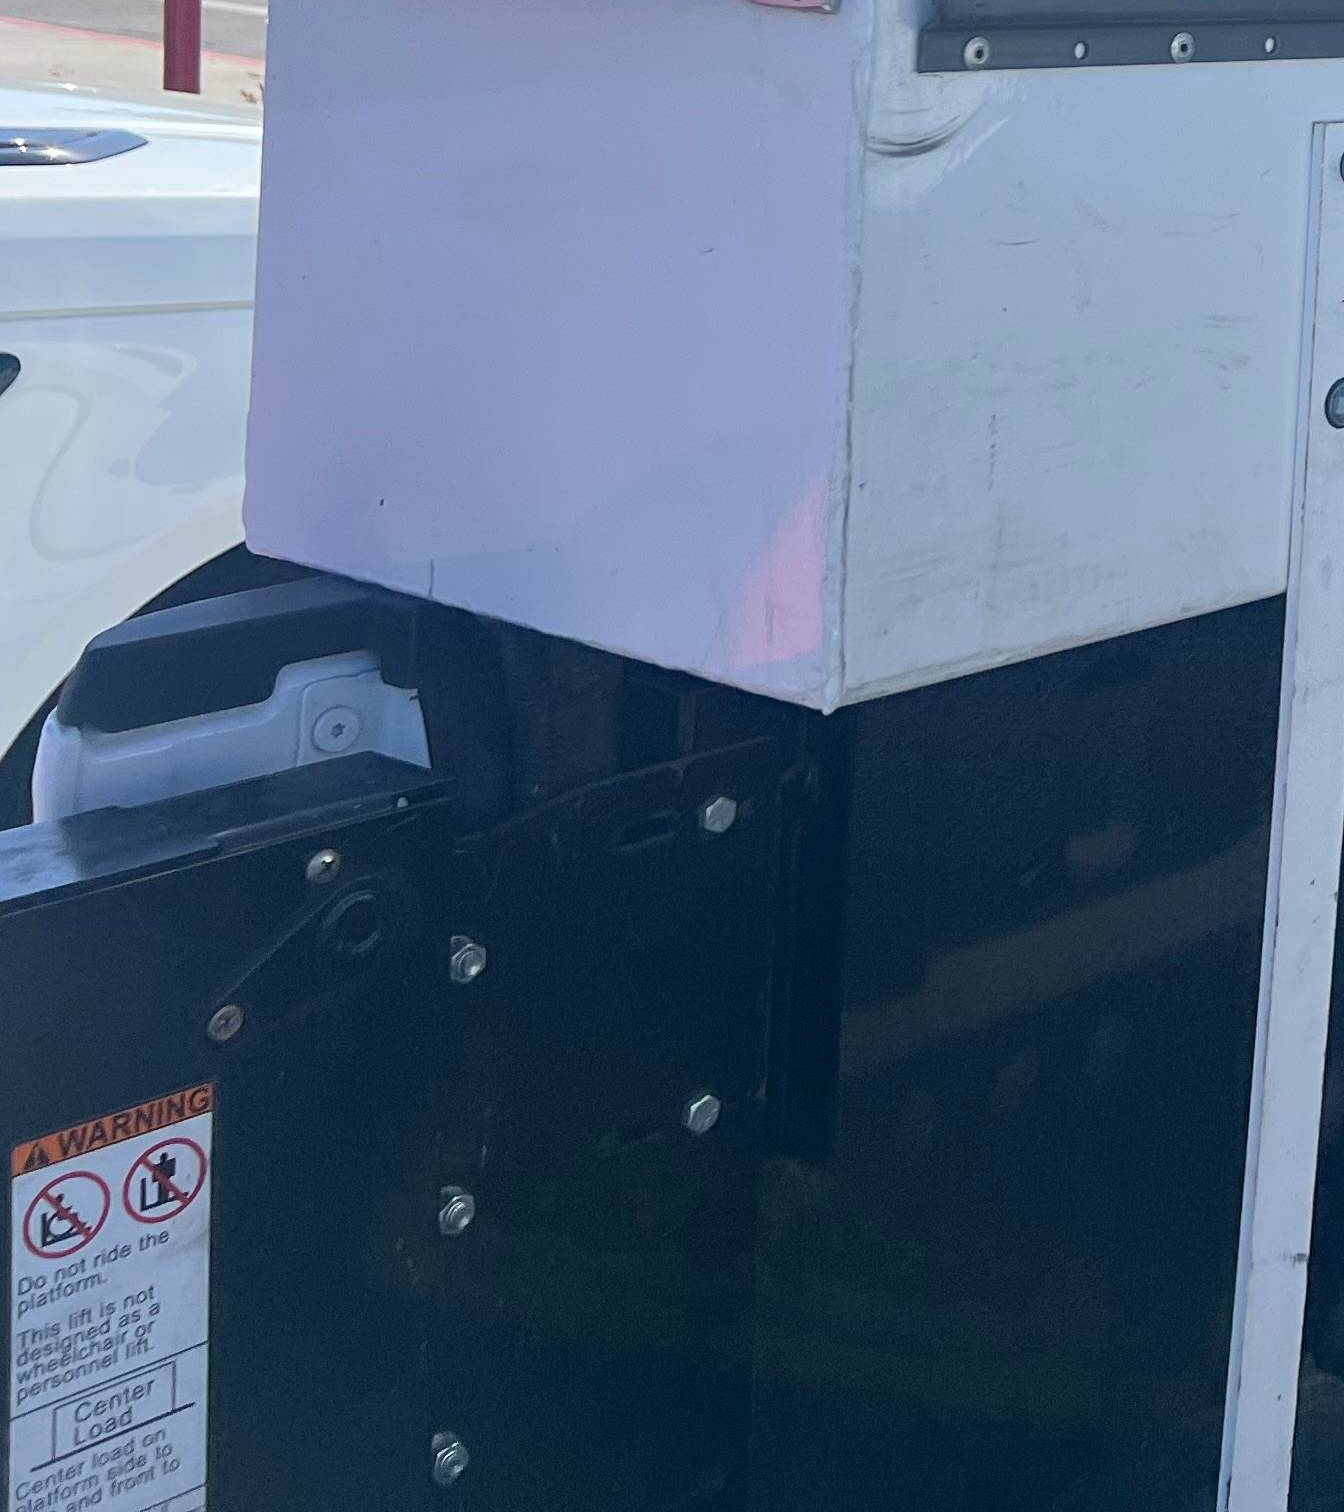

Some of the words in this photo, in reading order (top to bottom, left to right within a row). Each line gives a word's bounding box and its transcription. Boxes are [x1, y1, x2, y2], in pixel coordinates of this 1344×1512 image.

[61, 1087, 210, 1157] WARNING
[17, 1275, 46, 1296] Do
[54, 1258, 86, 1283] not
[93, 1244, 132, 1268] ride
[139, 1230, 169, 1251] the
[17, 1272, 108, 1319] platform.
[17, 1322, 61, 1348] This
[69, 1308, 92, 1330] lift
[100, 1302, 116, 1319] is
[123, 1285, 155, 1310] not
[16, 1318, 110, 1366] designed
[118, 1309, 141, 1328] as
[149, 1302, 161, 1316] a
[16, 1330, 128, 1384] wheelchair
[135, 1319, 156, 1338] or
[16, 1347, 118, 1407] personnel
[125, 1338, 155, 1359] lift.
[74, 1379, 155, 1423] Center
[73, 1406, 133, 1446] Load
[15, 1460, 86, 1501] Center
[91, 1440, 135, 1468] load
[142, 1429, 166, 1447] on
[66, 1489, 103, 1512] and
[111, 1467, 155, 1496] front
[163, 1457, 181, 1475] to
[107, 1454, 147, 1481] side
[156, 1443, 173, 1460] to
